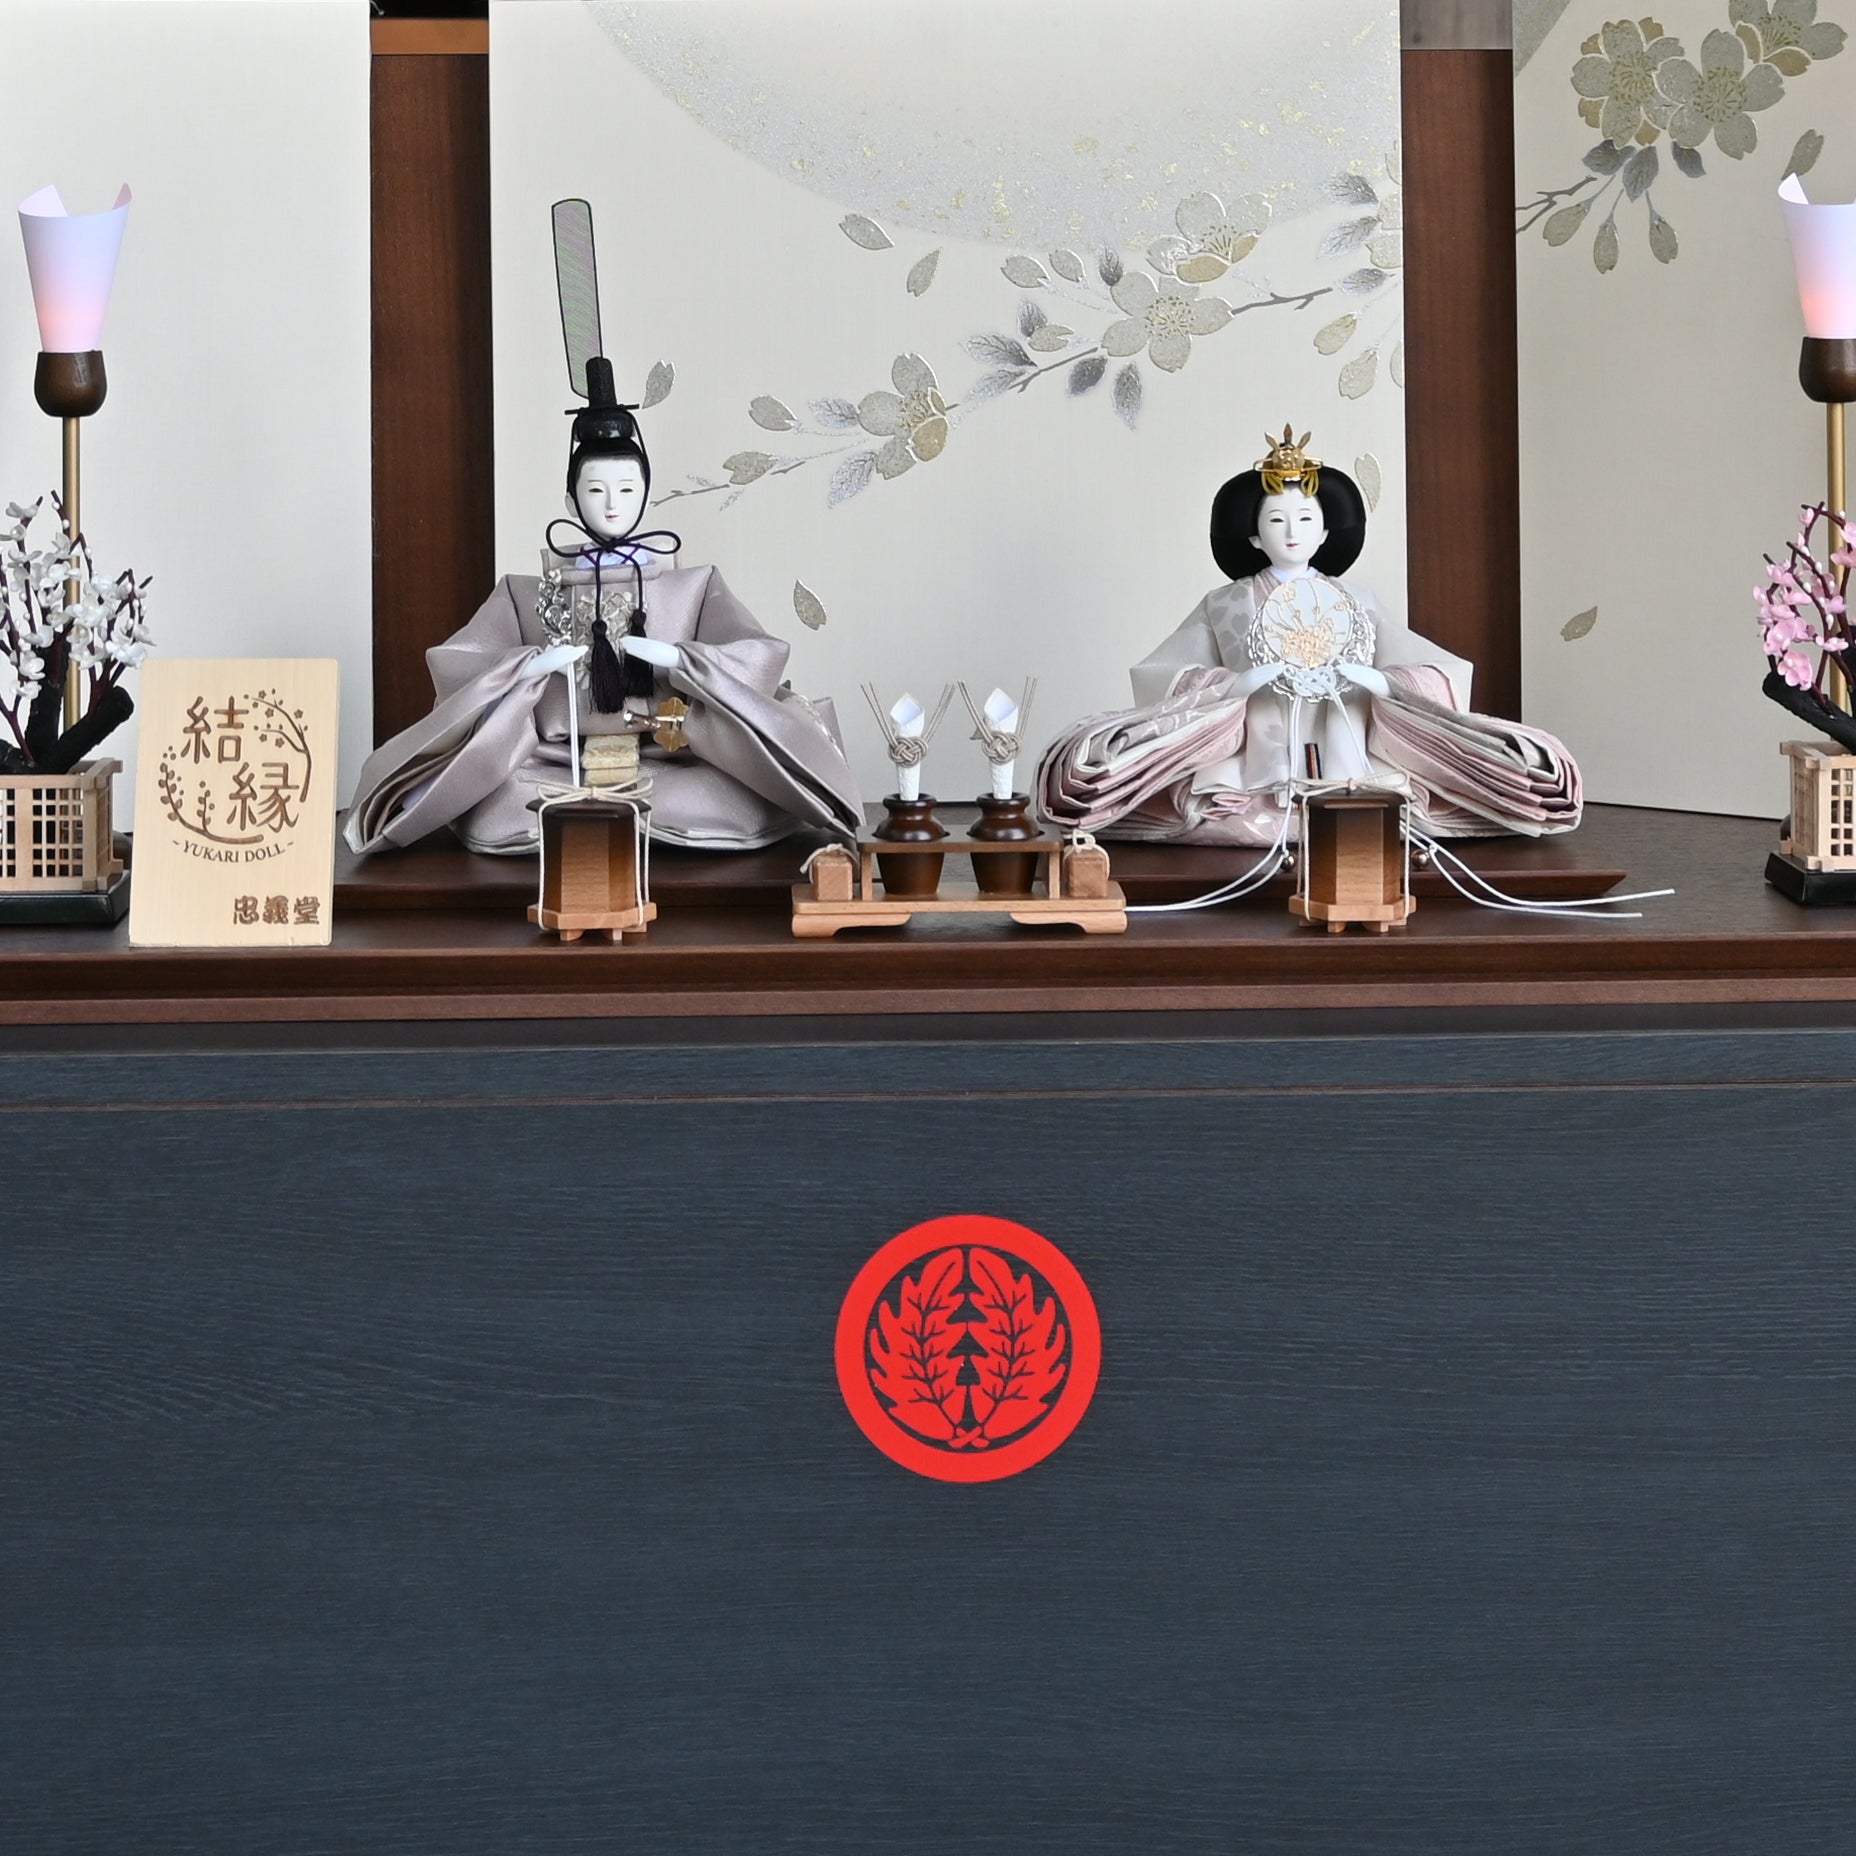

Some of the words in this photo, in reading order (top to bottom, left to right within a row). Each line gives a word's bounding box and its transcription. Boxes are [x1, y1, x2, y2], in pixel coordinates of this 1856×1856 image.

[180, 695, 300, 833] 結縁
[182, 839, 240, 863] YUKARI
[244, 843, 286, 863] DOLL
